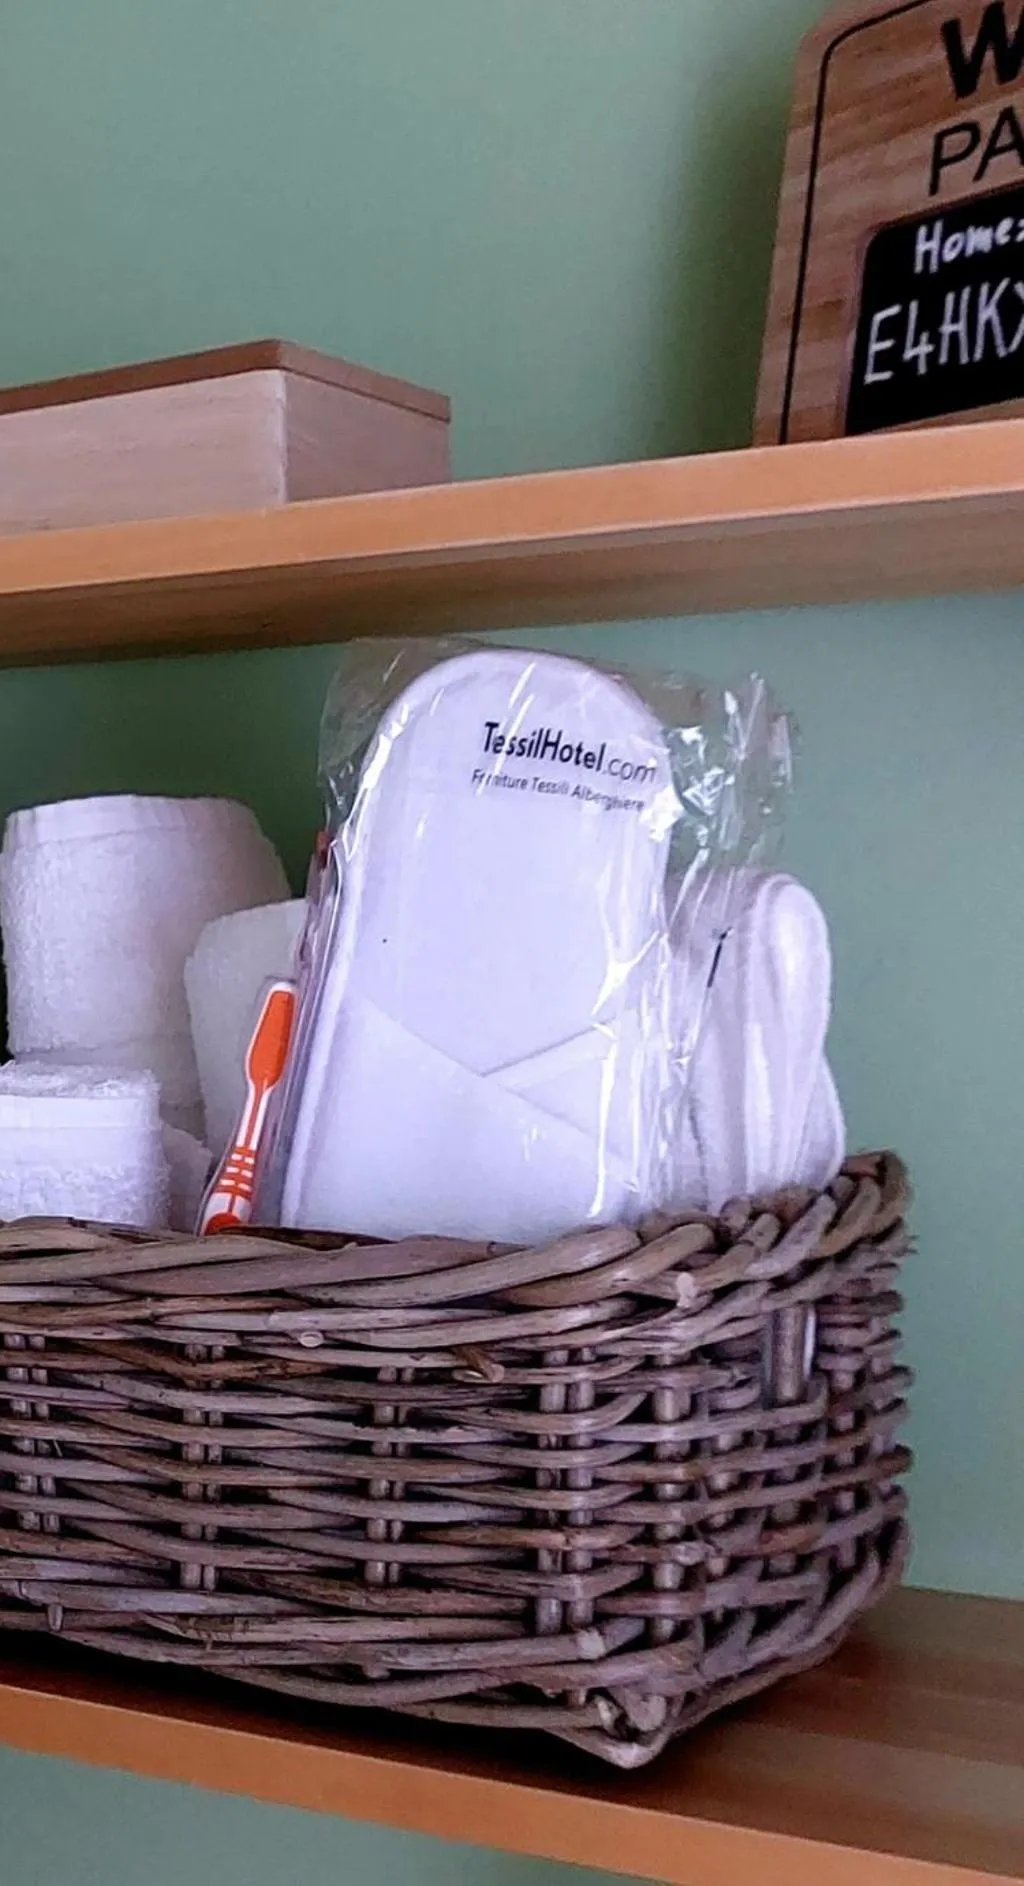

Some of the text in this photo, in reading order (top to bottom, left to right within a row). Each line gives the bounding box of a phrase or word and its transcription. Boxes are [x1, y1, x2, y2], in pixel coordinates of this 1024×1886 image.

[941, 0, 1024, 99] W
[928, 106, 1024, 196] PA
[483, 721, 657, 783] TessilHotel.com
